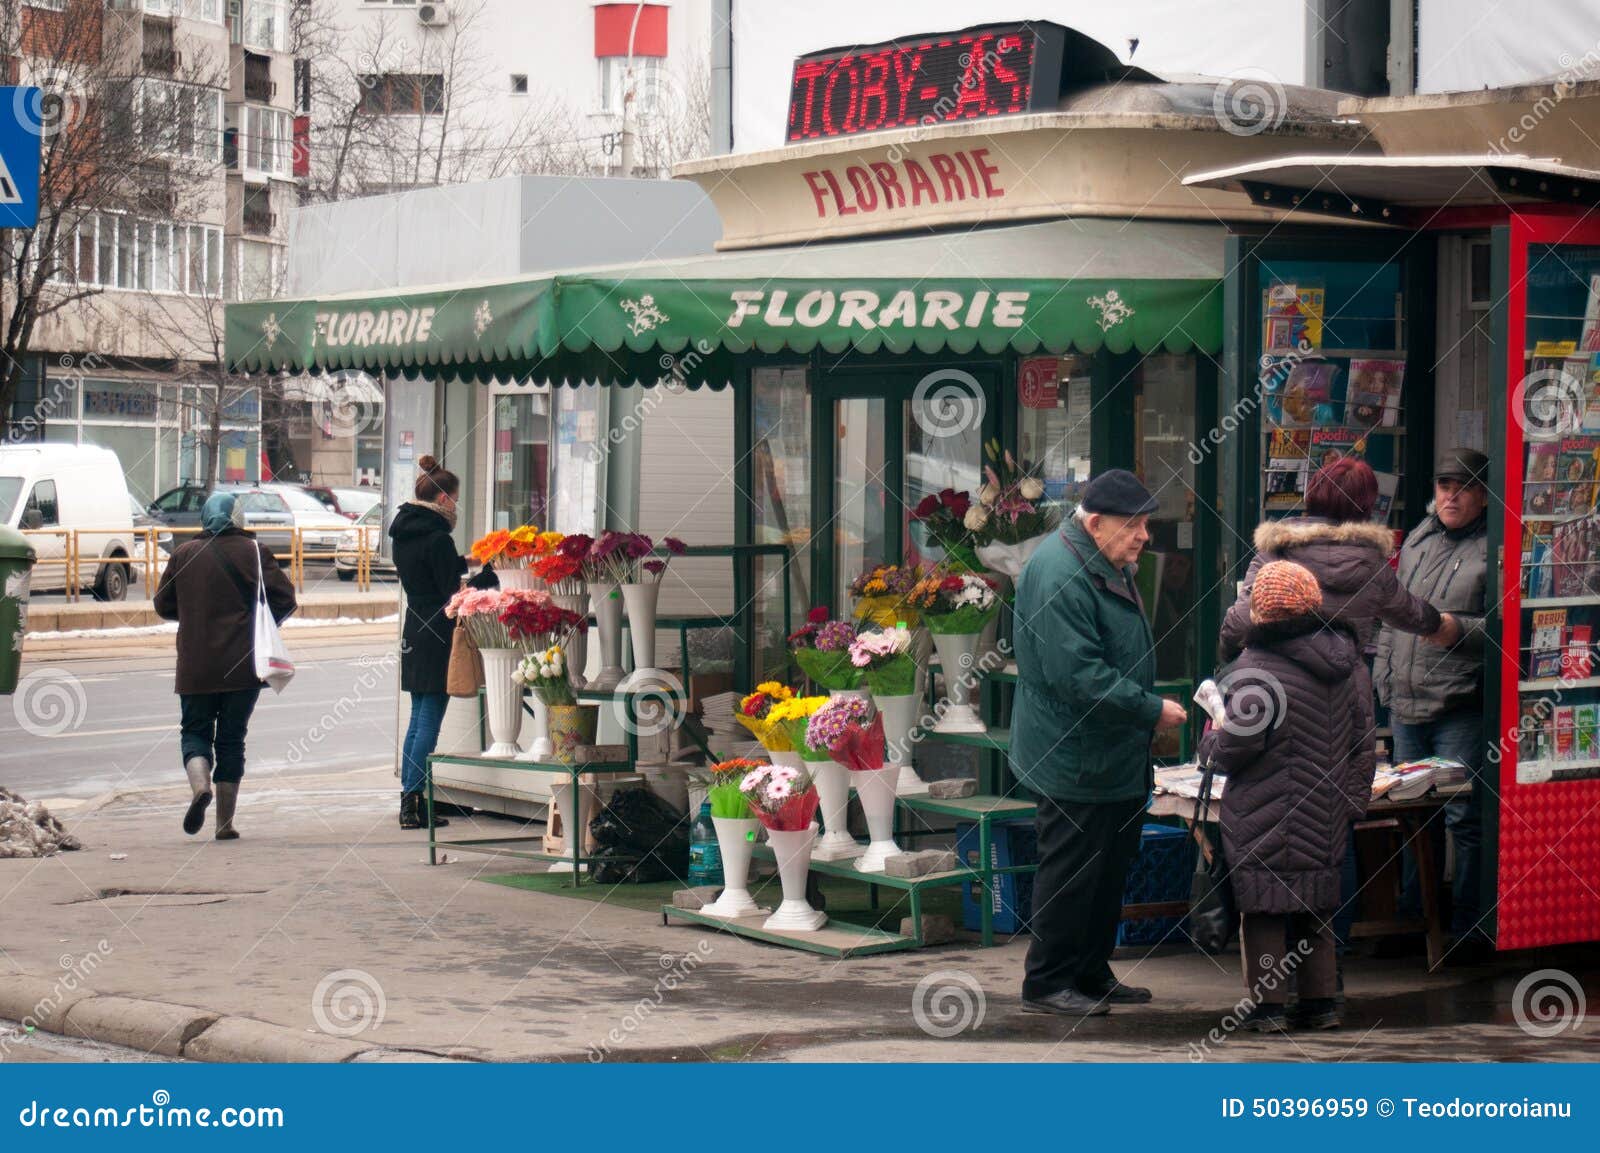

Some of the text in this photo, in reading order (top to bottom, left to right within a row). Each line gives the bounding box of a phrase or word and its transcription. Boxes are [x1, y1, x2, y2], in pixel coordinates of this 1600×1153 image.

[803, 148, 1005, 218] FLORARIE
[311, 308, 435, 347] FLORARIE
[727, 289, 1030, 330] FLORARIE
[1537, 611, 1567, 626] REBUS
